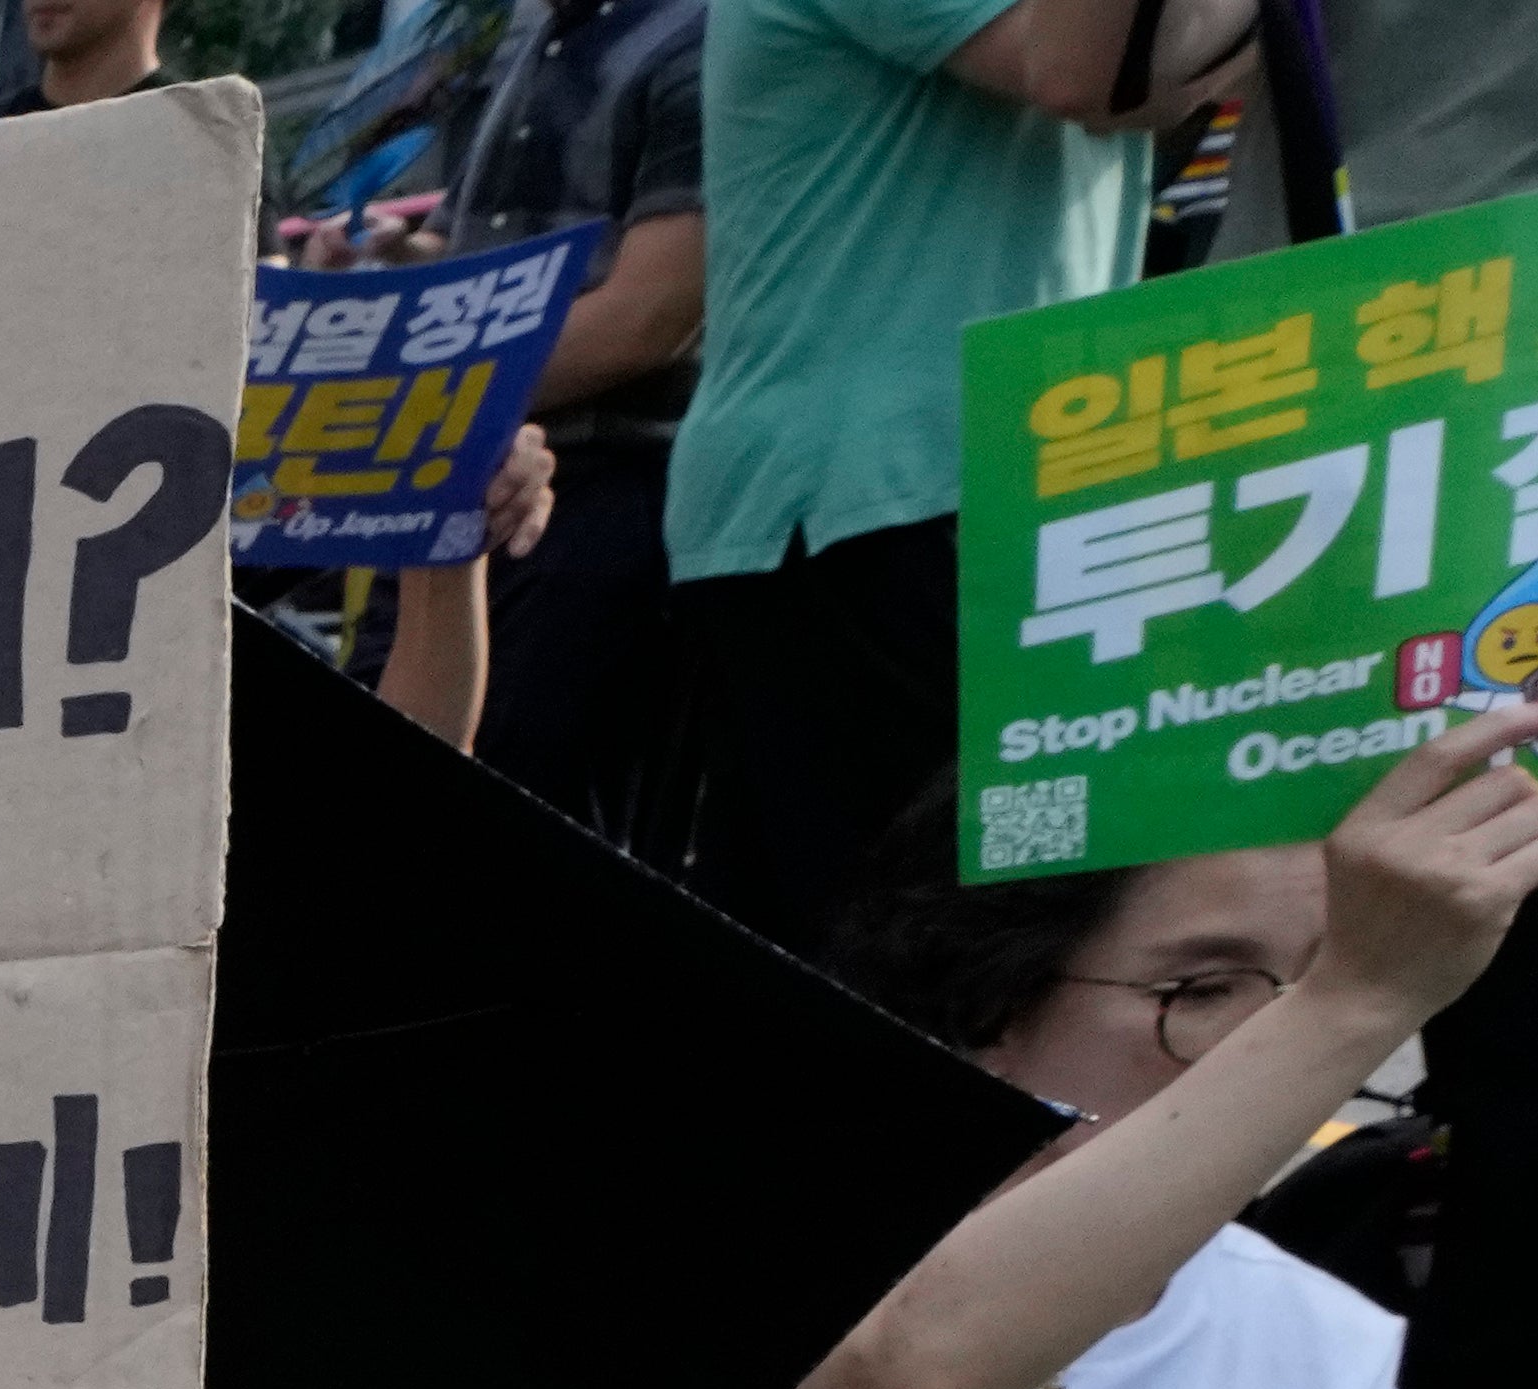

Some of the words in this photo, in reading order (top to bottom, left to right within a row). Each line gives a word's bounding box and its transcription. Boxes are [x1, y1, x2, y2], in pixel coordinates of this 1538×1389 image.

[399, 242, 571, 365] 정권
[1029, 313, 1319, 499] 일본
[1356, 256, 1515, 391] 핵
[334, 510, 435, 539] Japan
[1020, 418, 1446, 665] 투기
[1000, 707, 1138, 763] Stop
[1148, 651, 1385, 732] Nuclear
[1411, 637, 1446, 703] NO
[1228, 707, 1448, 782] Ocean
